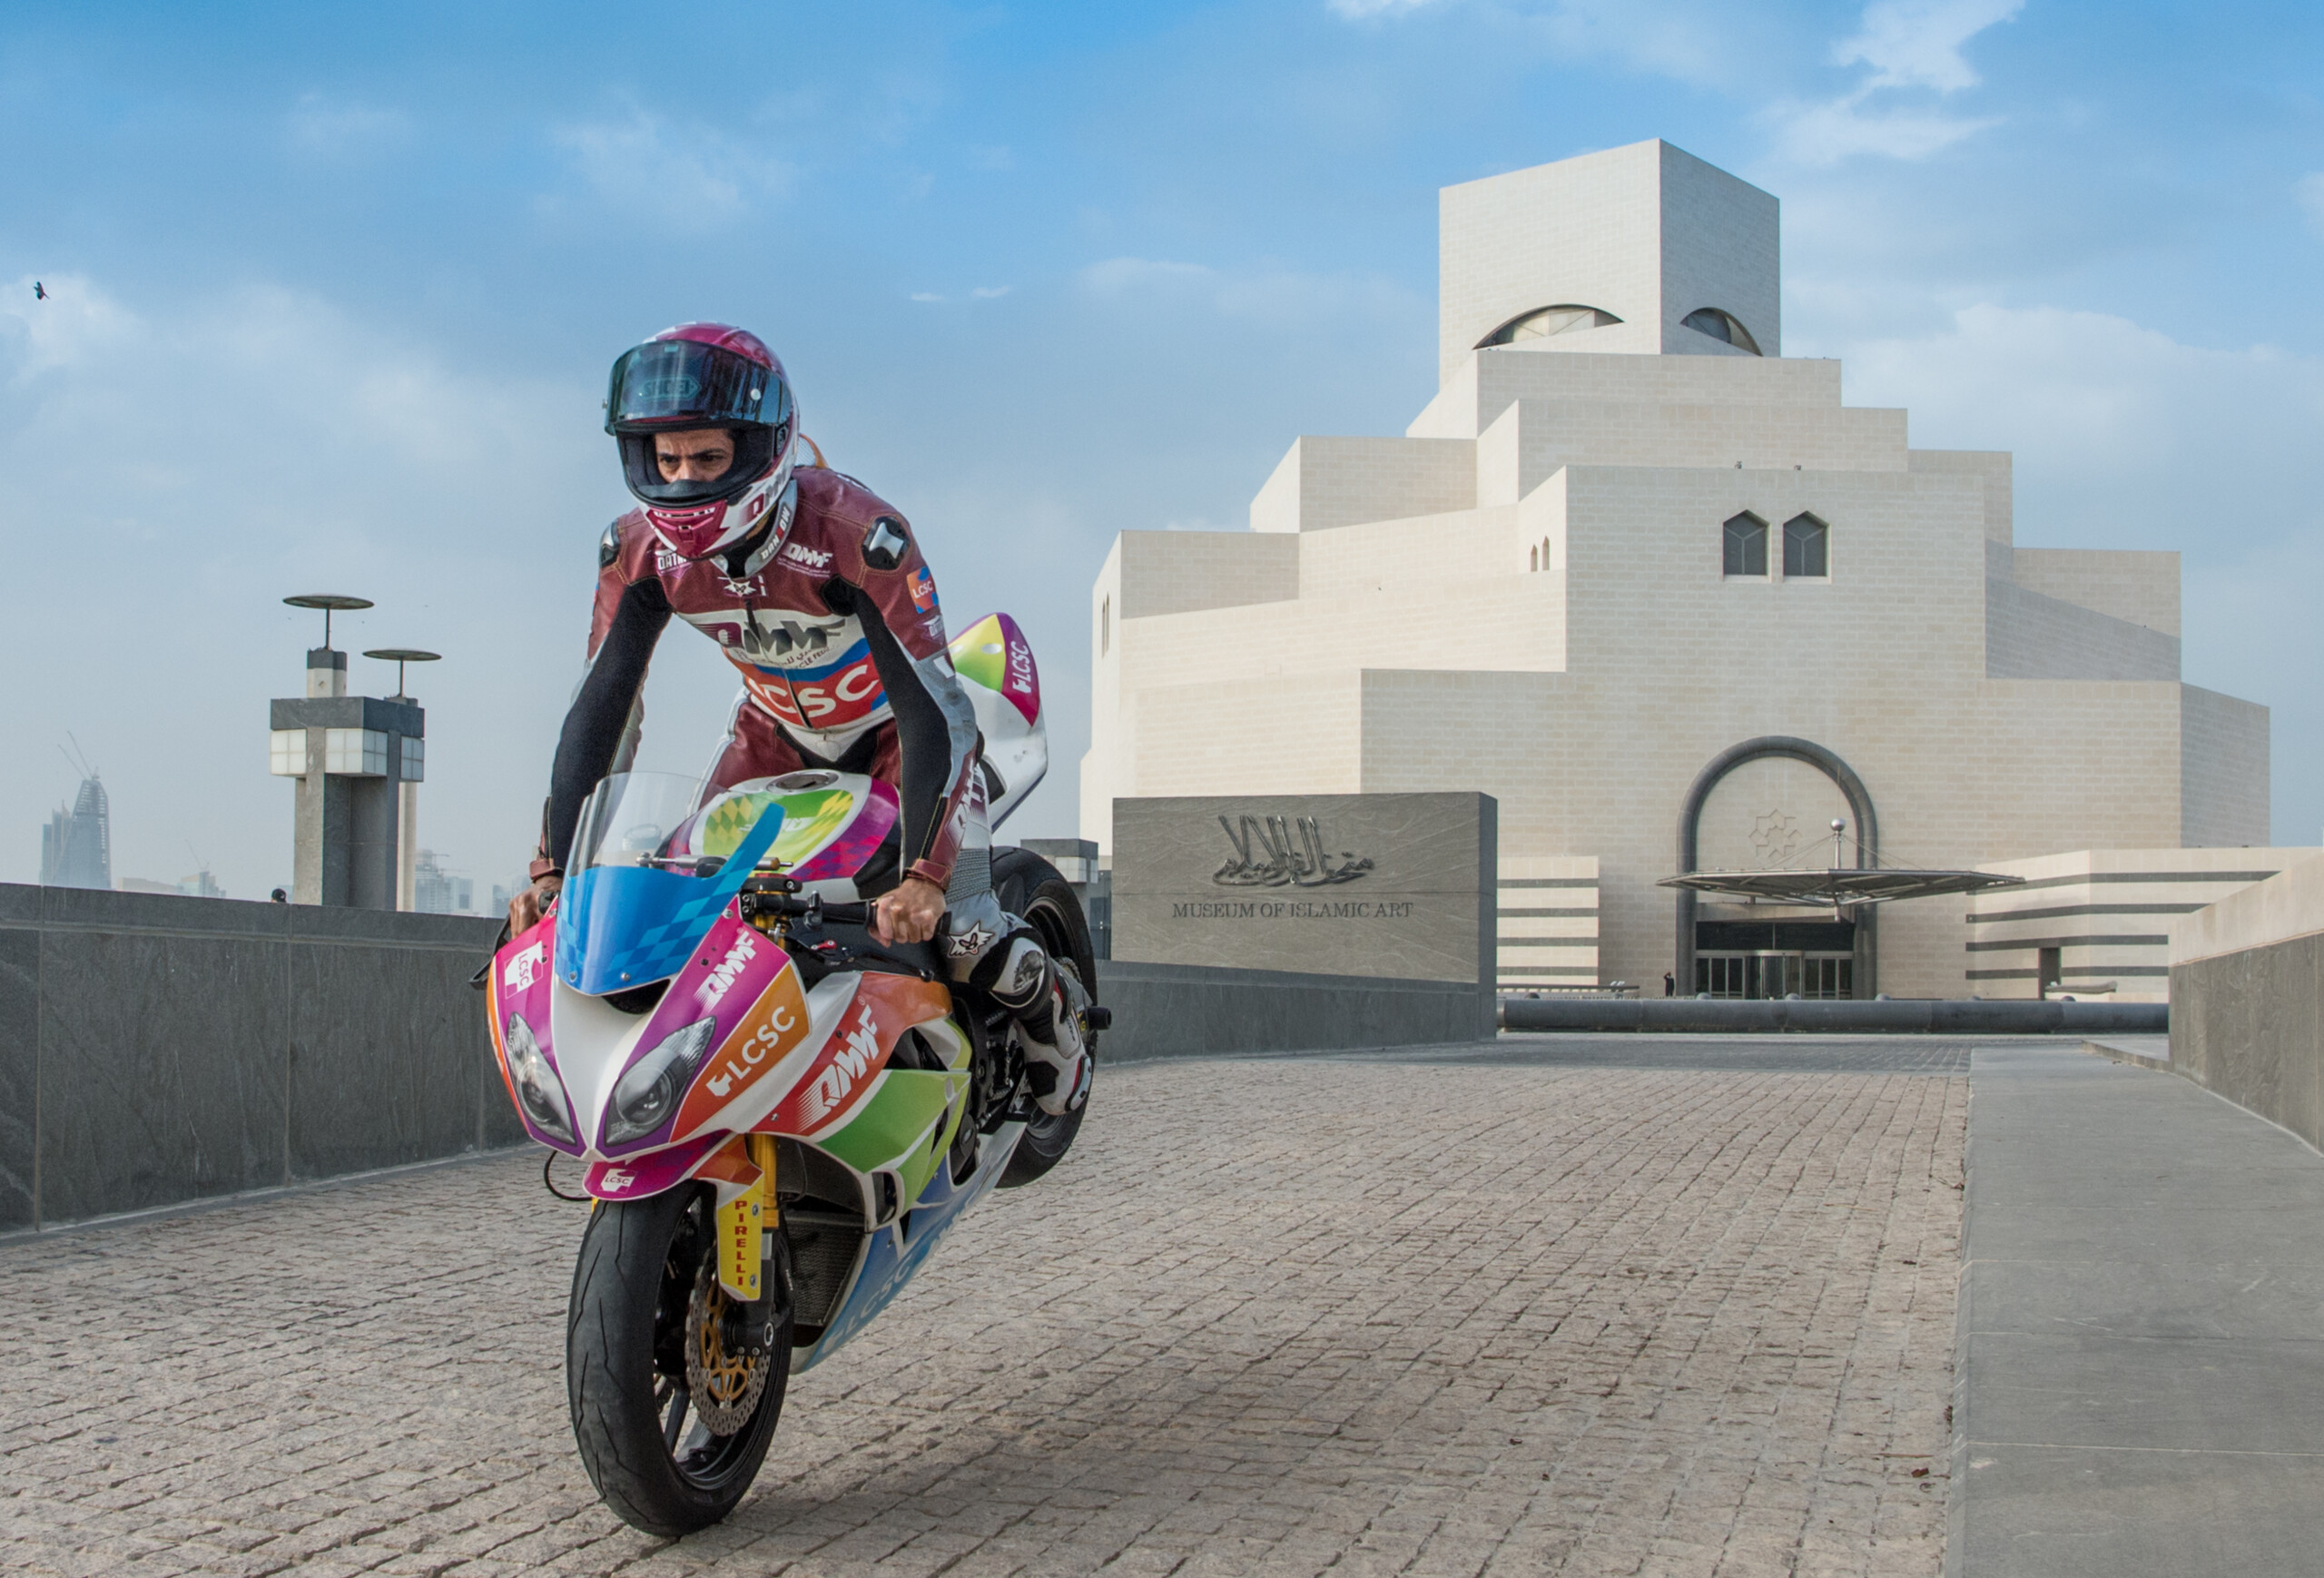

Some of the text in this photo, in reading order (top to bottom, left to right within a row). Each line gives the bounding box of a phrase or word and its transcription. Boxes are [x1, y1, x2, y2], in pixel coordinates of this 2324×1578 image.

[912, 581, 933, 598] LCSC
[1009, 641, 1032, 683] LCSC
[1172, 902, 1414, 919] MUSEUM OF ISLAMIC ART
[518, 952, 530, 987] LCSC
[725, 1005, 796, 1080] LCSC
[605, 1176, 630, 1185] LCSC
[734, 1200, 748, 1287] PIRELLI
